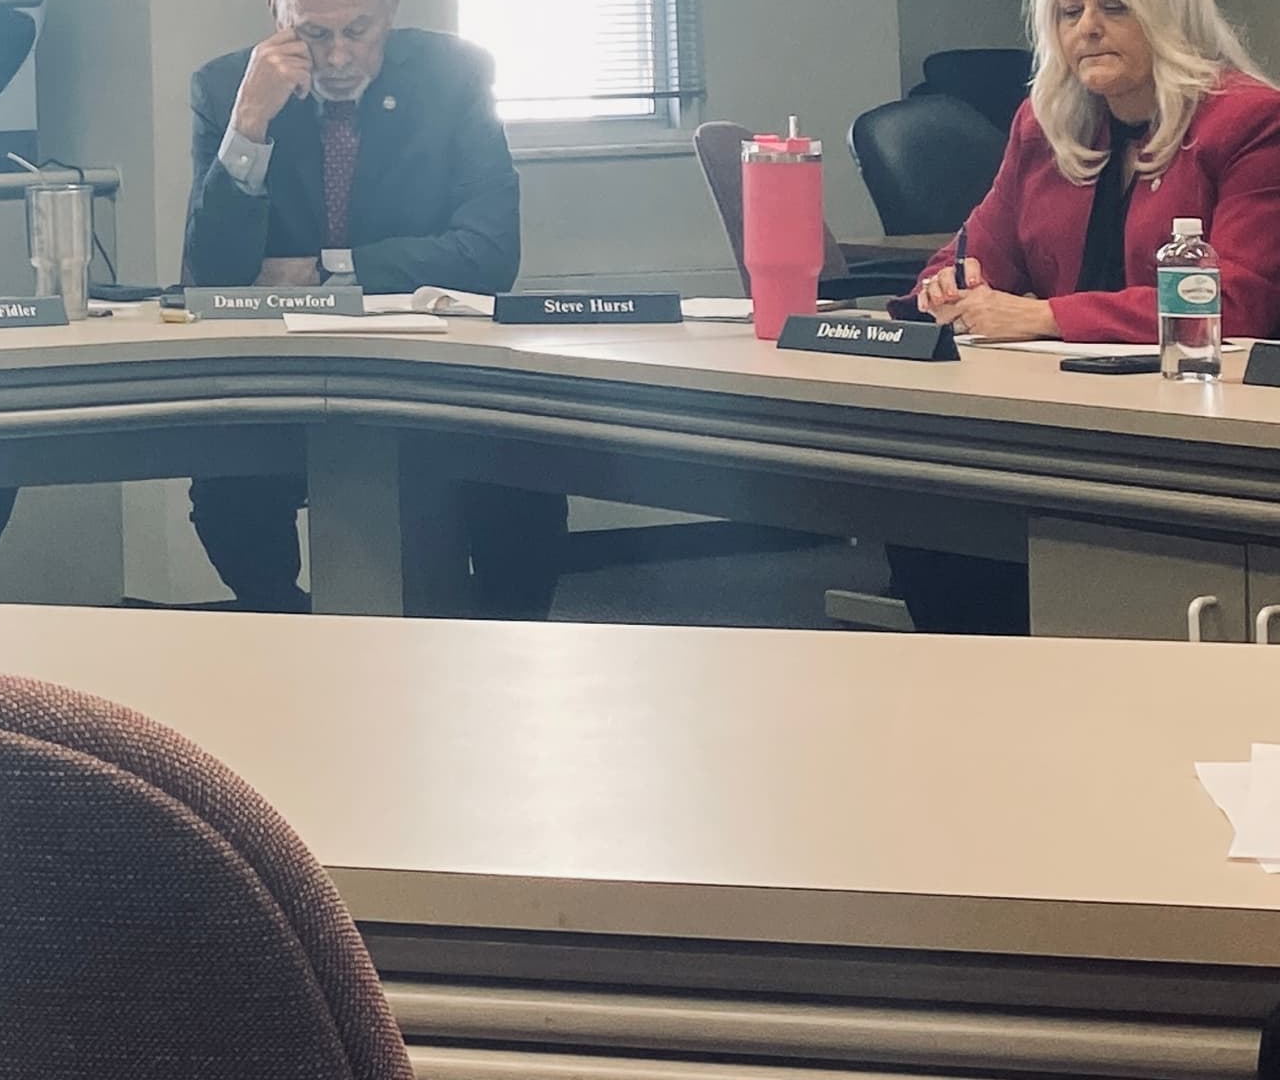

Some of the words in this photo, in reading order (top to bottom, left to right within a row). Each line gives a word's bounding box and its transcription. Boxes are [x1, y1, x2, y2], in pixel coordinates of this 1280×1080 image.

[214, 295, 261, 310] Danny
[266, 294, 336, 308] Crawford
[544, 299, 584, 313] Steve
[590, 298, 634, 313] Hurst
[816, 322, 862, 340] Debbie
[866, 326, 904, 342] Wood
